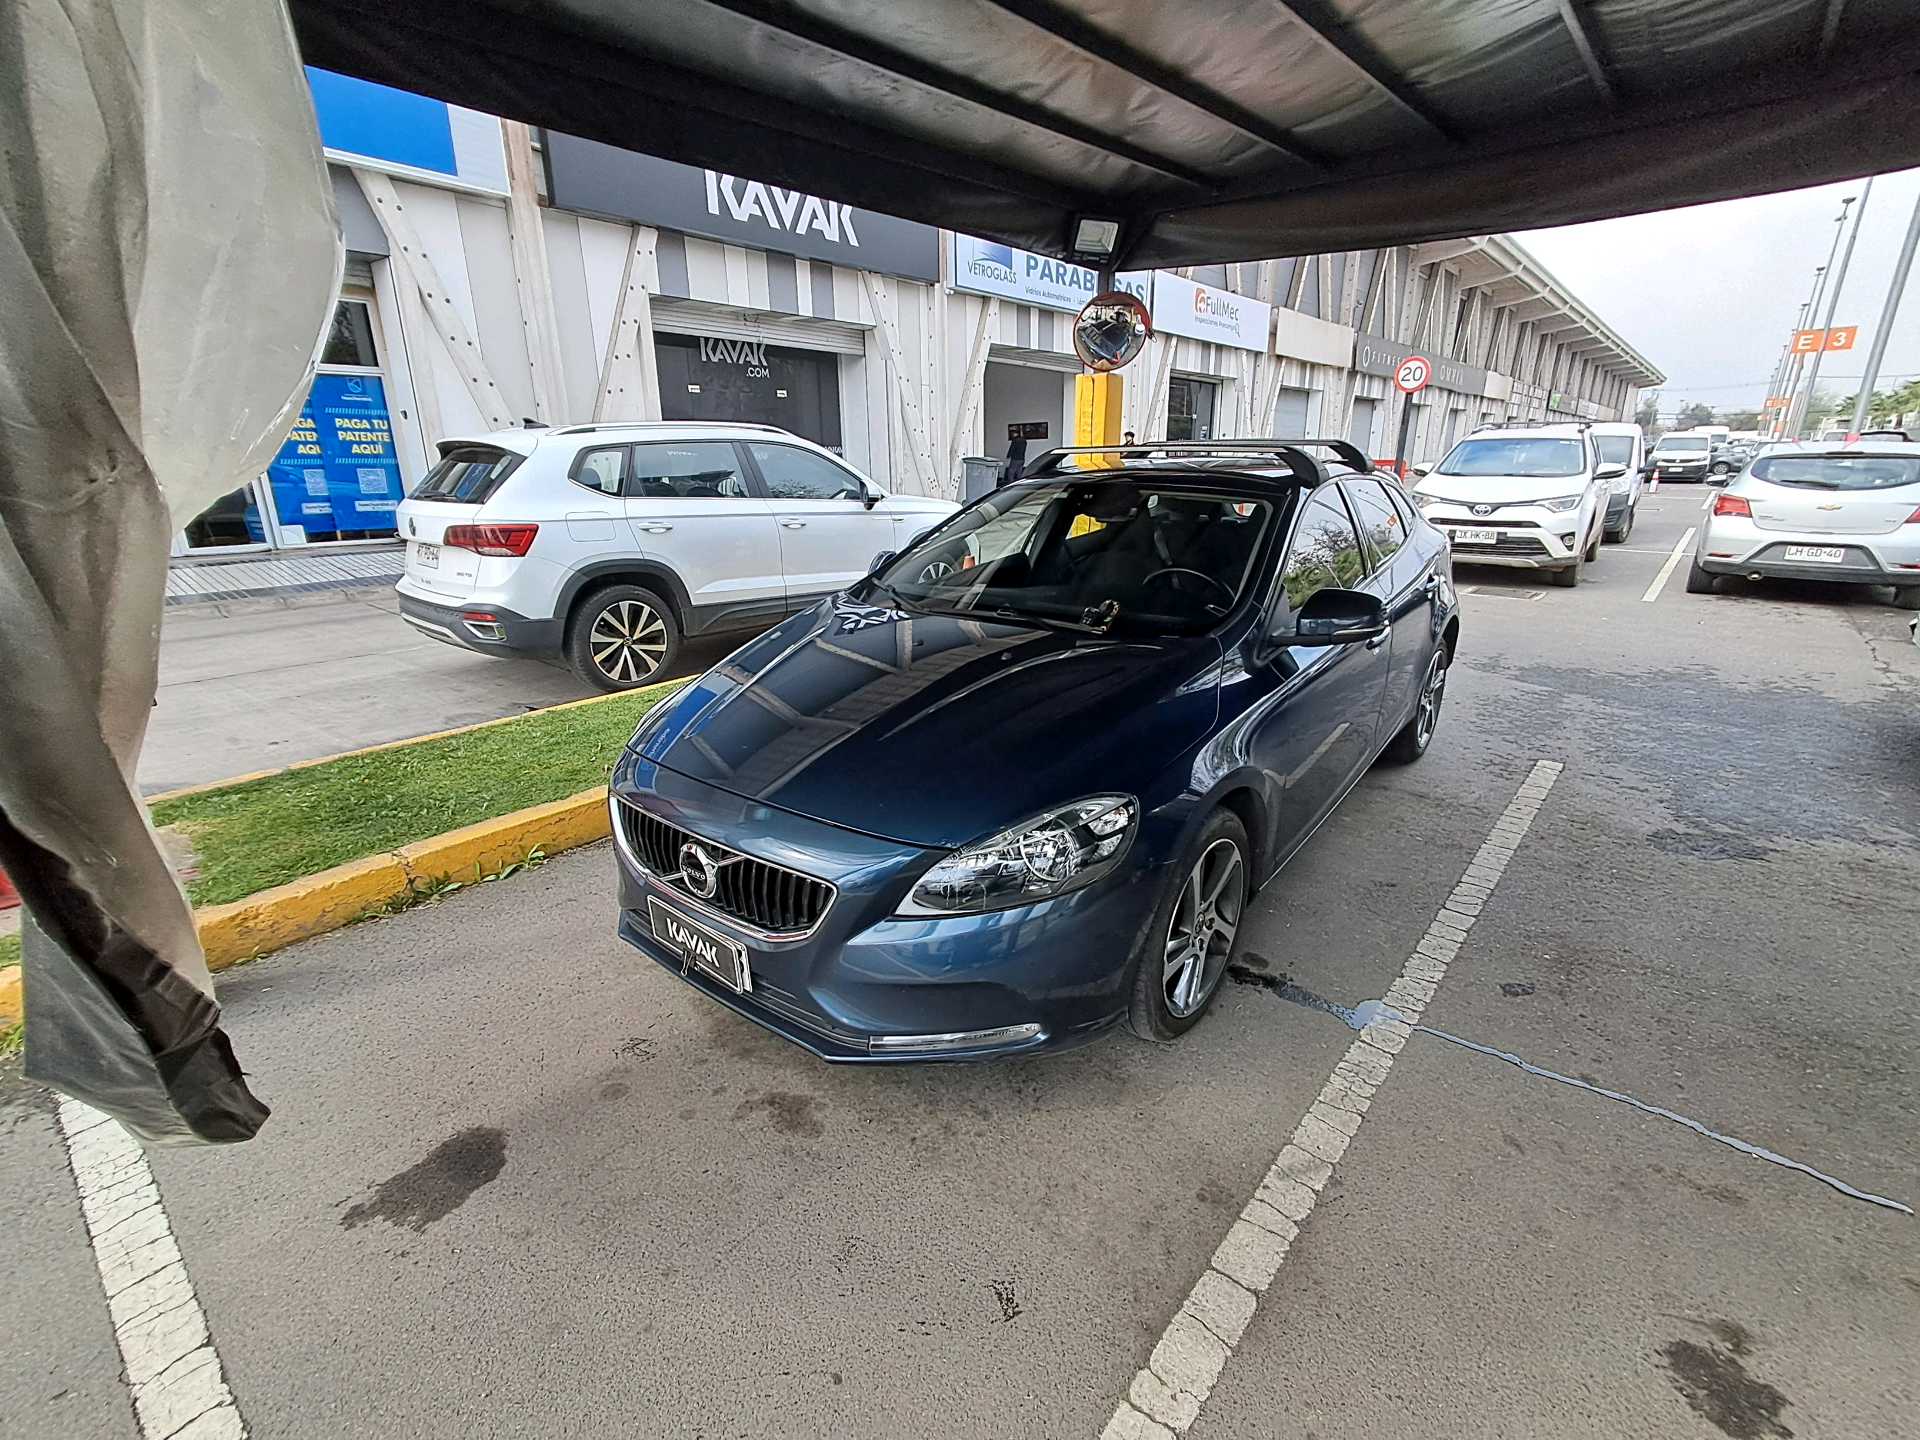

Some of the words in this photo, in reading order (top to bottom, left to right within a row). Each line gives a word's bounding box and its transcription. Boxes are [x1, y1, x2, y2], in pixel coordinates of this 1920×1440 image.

[704, 168, 860, 248] KAVAK
[967, 261, 1017, 285] VETROGLASS
[1025, 253, 1145, 301] PARABSAS
[1206, 296, 1239, 321] FullMec
[1797, 335, 1815, 350] E
[1832, 331, 1848, 347] 3
[700, 337, 768, 367] KAVAK
[746, 367, 770, 379] .COM
[1401, 366, 1424, 382] 20
[335, 417, 371, 429] PAGA
[372, 419, 388, 429] TU
[337, 431, 391, 442] PATENTE
[682, 864, 706, 880] VOLVO
[666, 917, 720, 968] KAVAK
